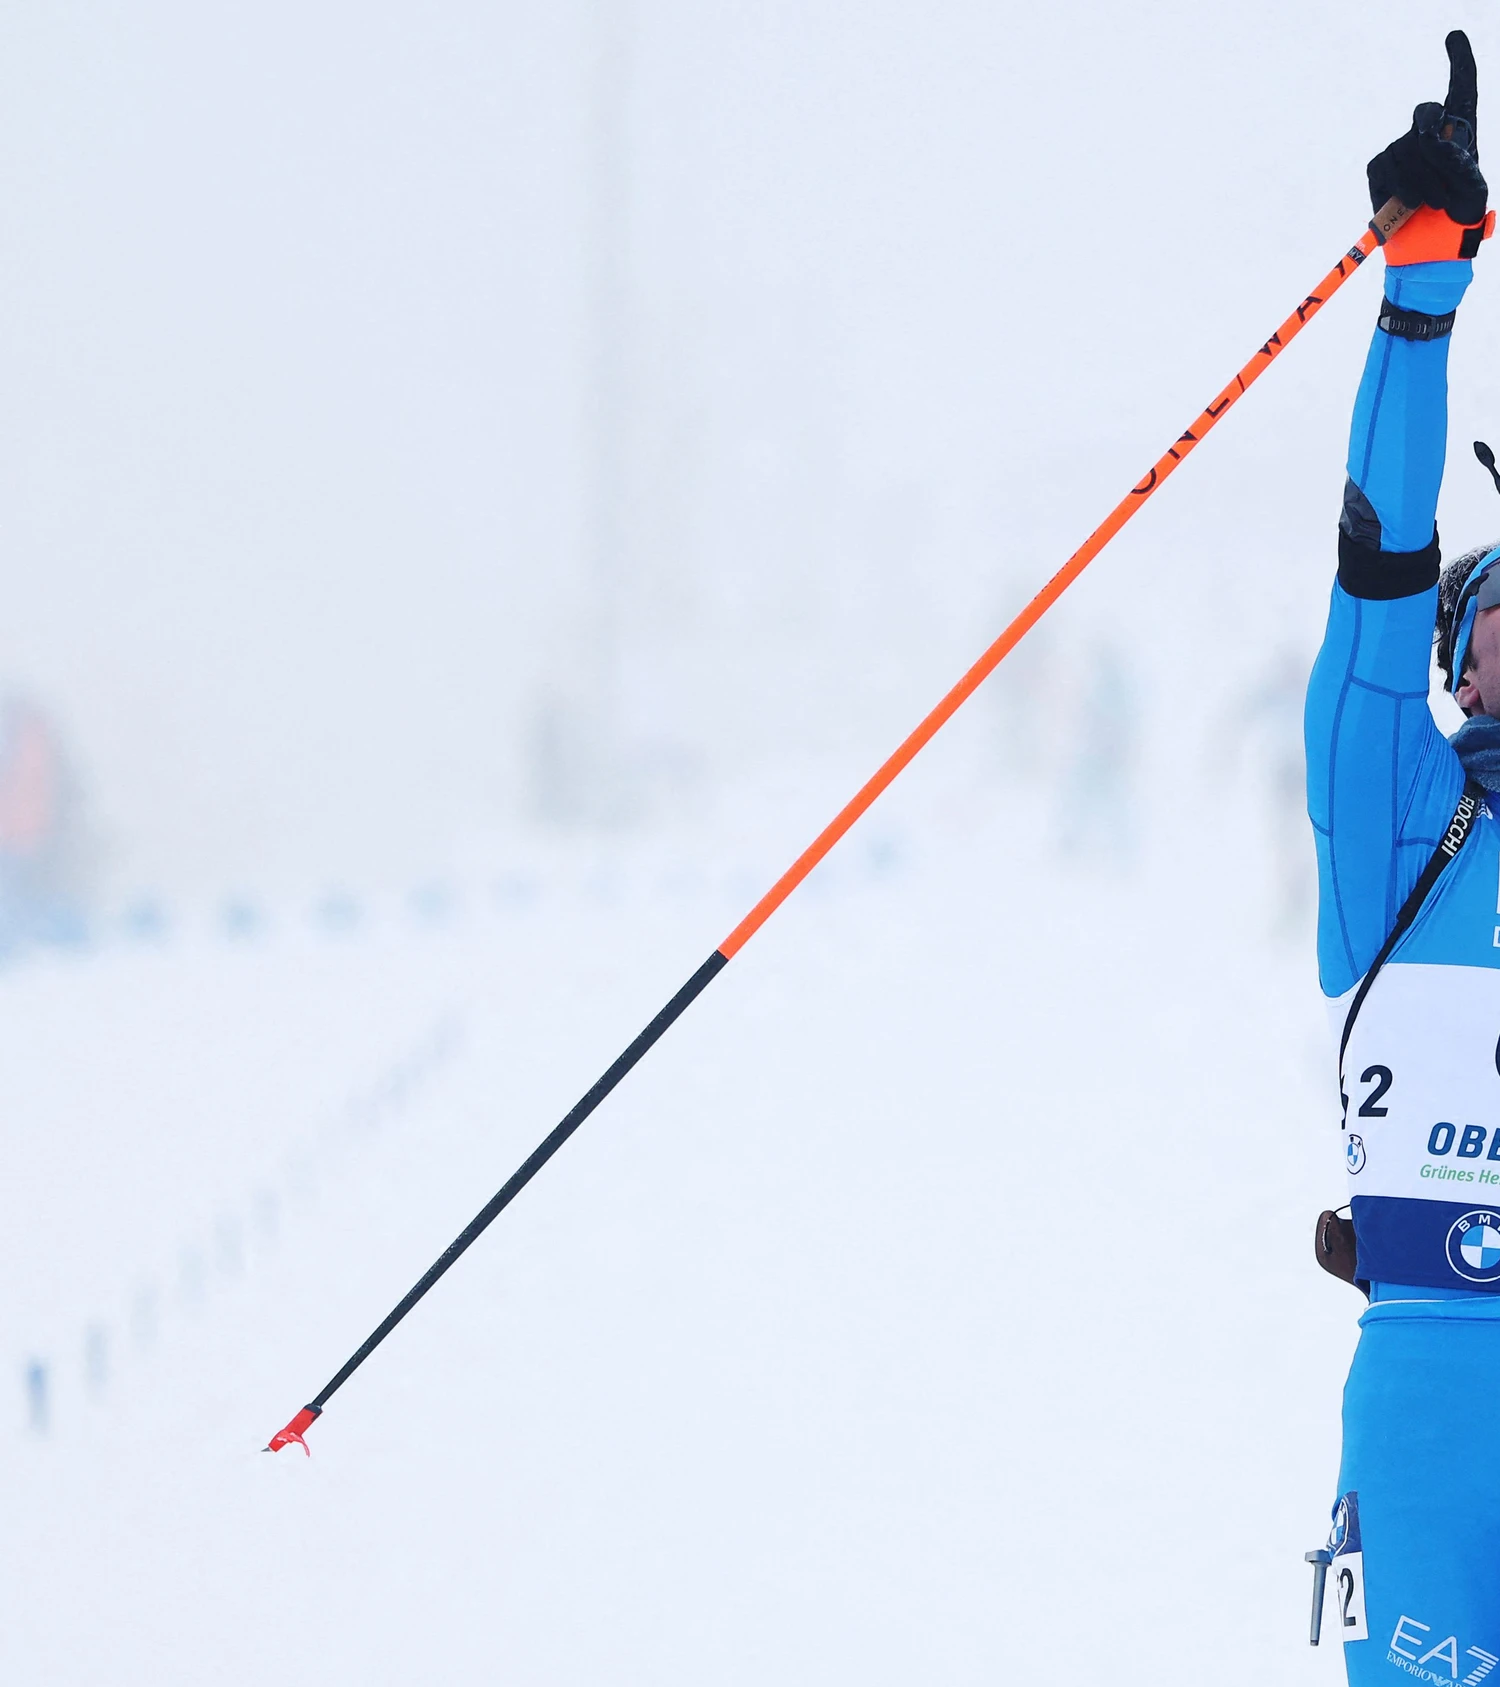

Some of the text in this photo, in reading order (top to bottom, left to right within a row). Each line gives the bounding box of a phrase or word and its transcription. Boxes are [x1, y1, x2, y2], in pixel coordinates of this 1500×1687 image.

[1441, 795, 1475, 857] FIOCCHI
[1419, 1163, 1475, 1182] Grünes
[1337, 1568, 1357, 1627] 2
[1386, 1650, 1433, 1682] EMPORIO
[1390, 1614, 1500, 1687] EA7
